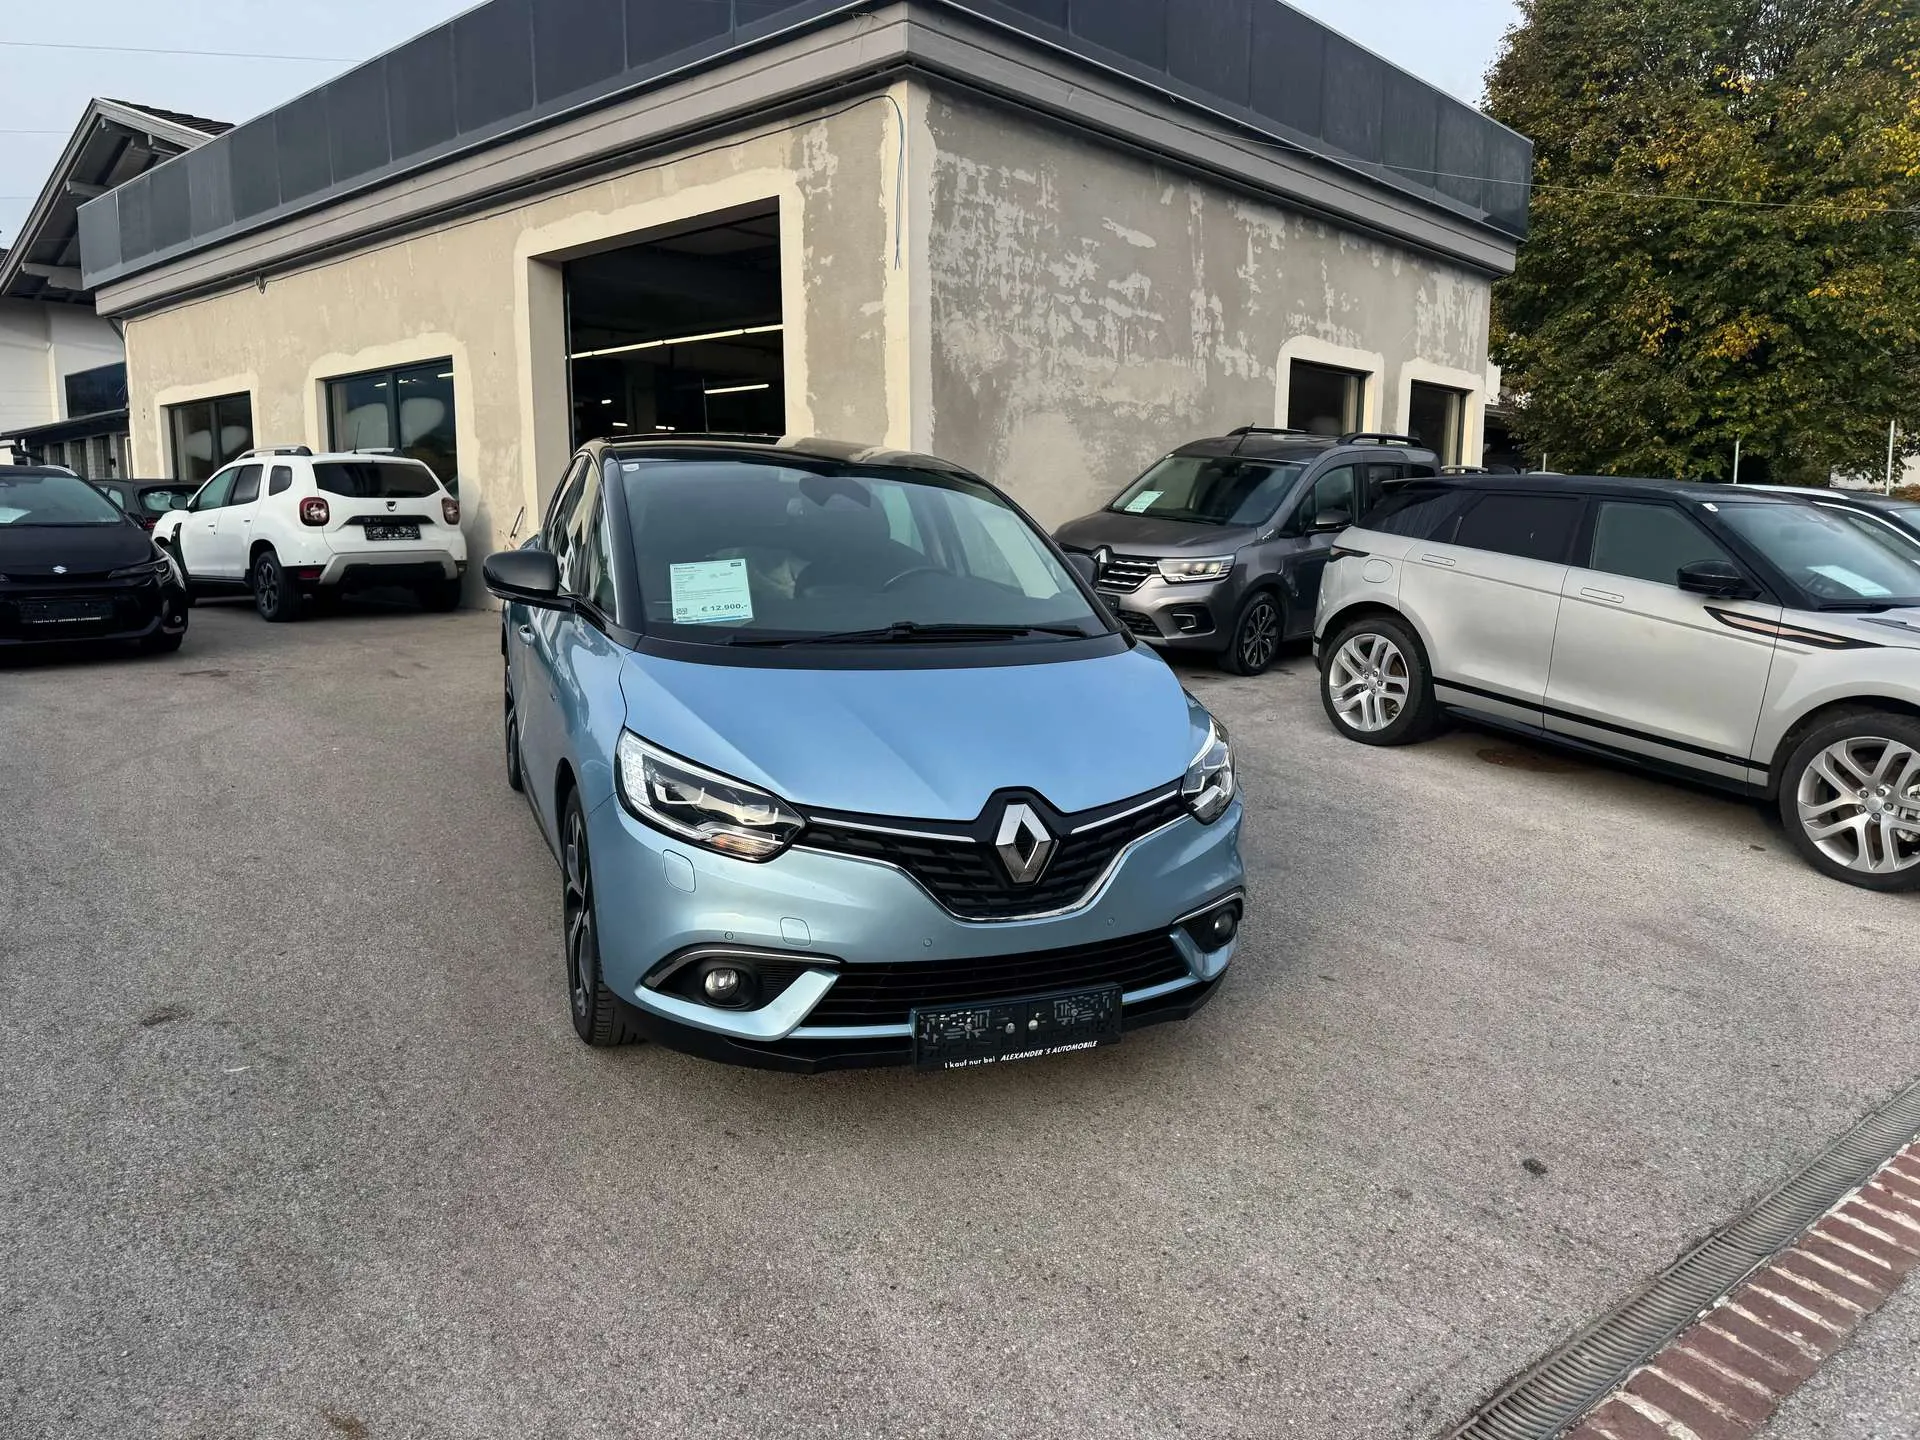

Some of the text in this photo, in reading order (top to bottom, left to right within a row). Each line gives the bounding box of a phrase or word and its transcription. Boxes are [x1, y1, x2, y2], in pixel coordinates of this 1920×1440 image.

[949, 1059, 967, 1068] kauf
[983, 1055, 996, 1064] bei
[1051, 1040, 1098, 1054] AUTOMOBILE
